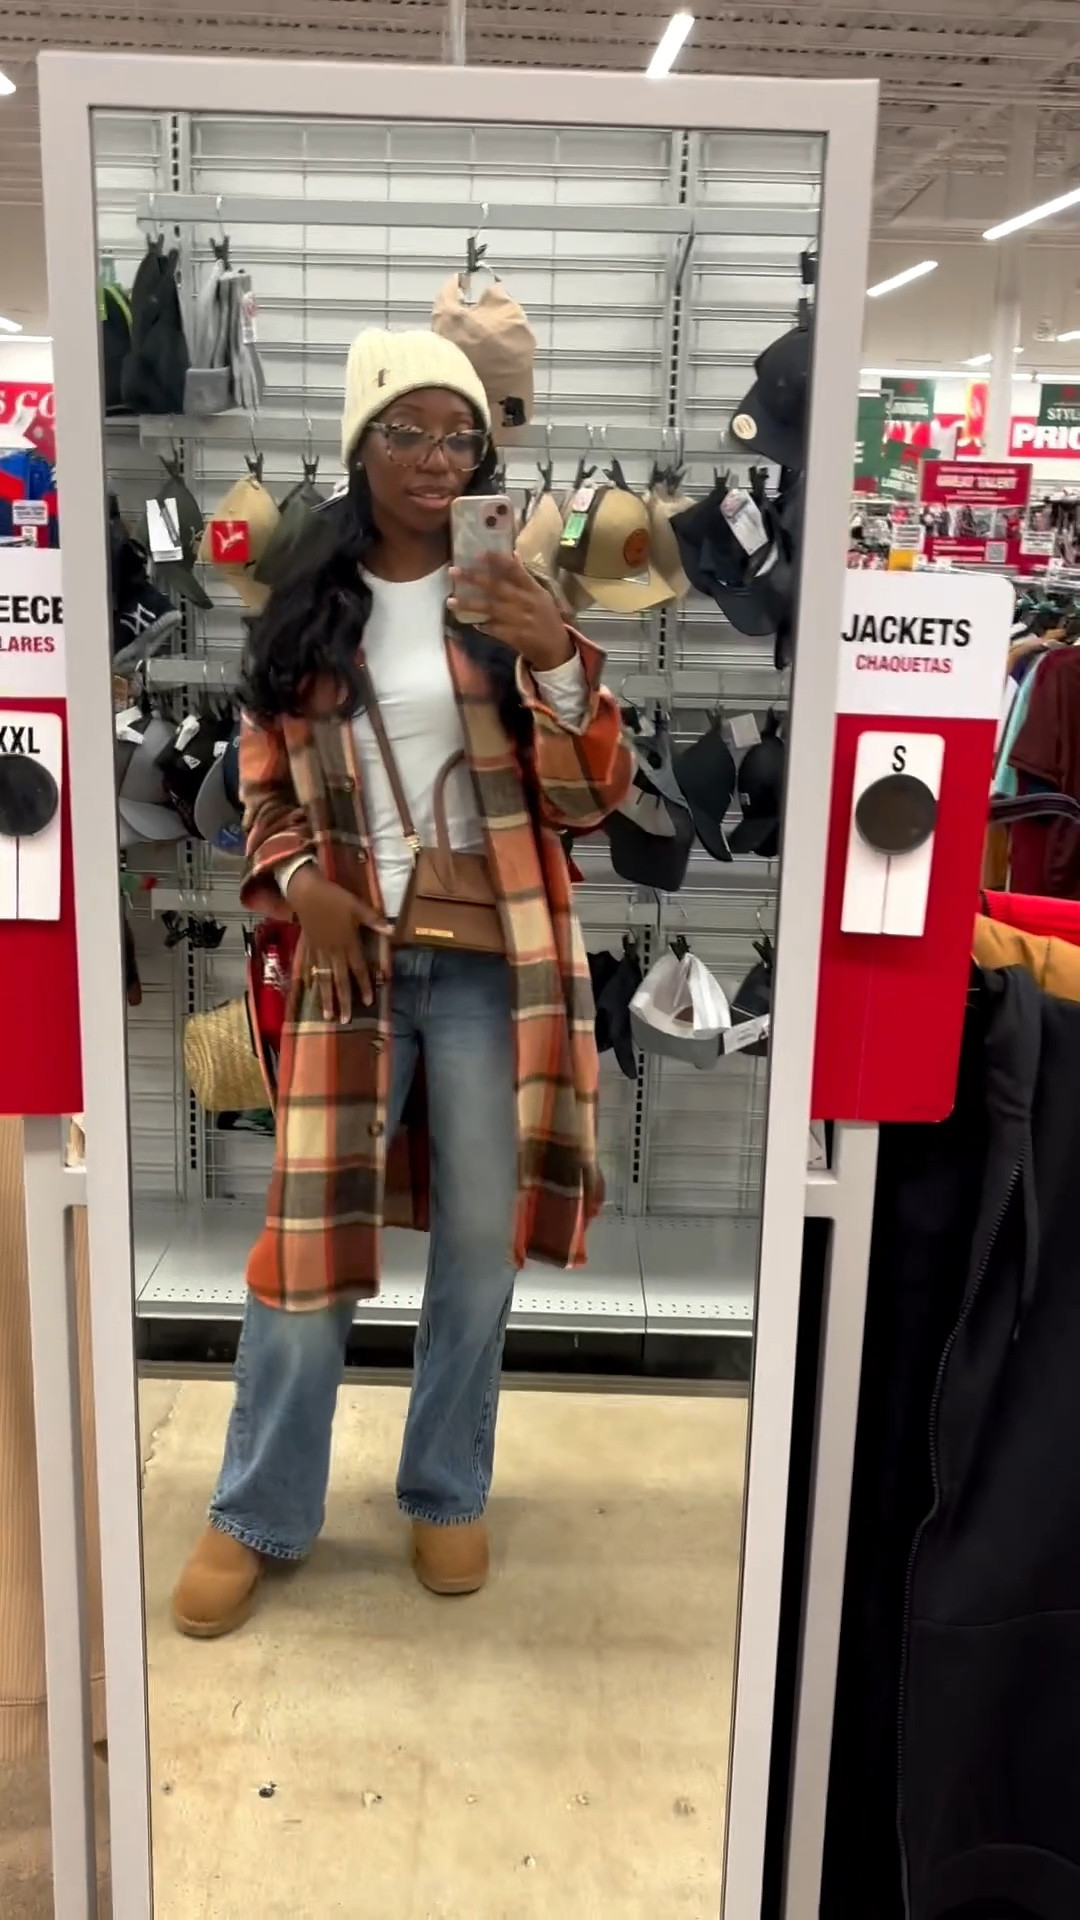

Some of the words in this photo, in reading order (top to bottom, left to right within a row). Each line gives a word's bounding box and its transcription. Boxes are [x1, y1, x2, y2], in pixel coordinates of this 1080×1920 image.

[841, 614, 972, 647] JACKETS
[855, 654, 952, 673] CHAQUETAS
[892, 744, 906, 773] S
